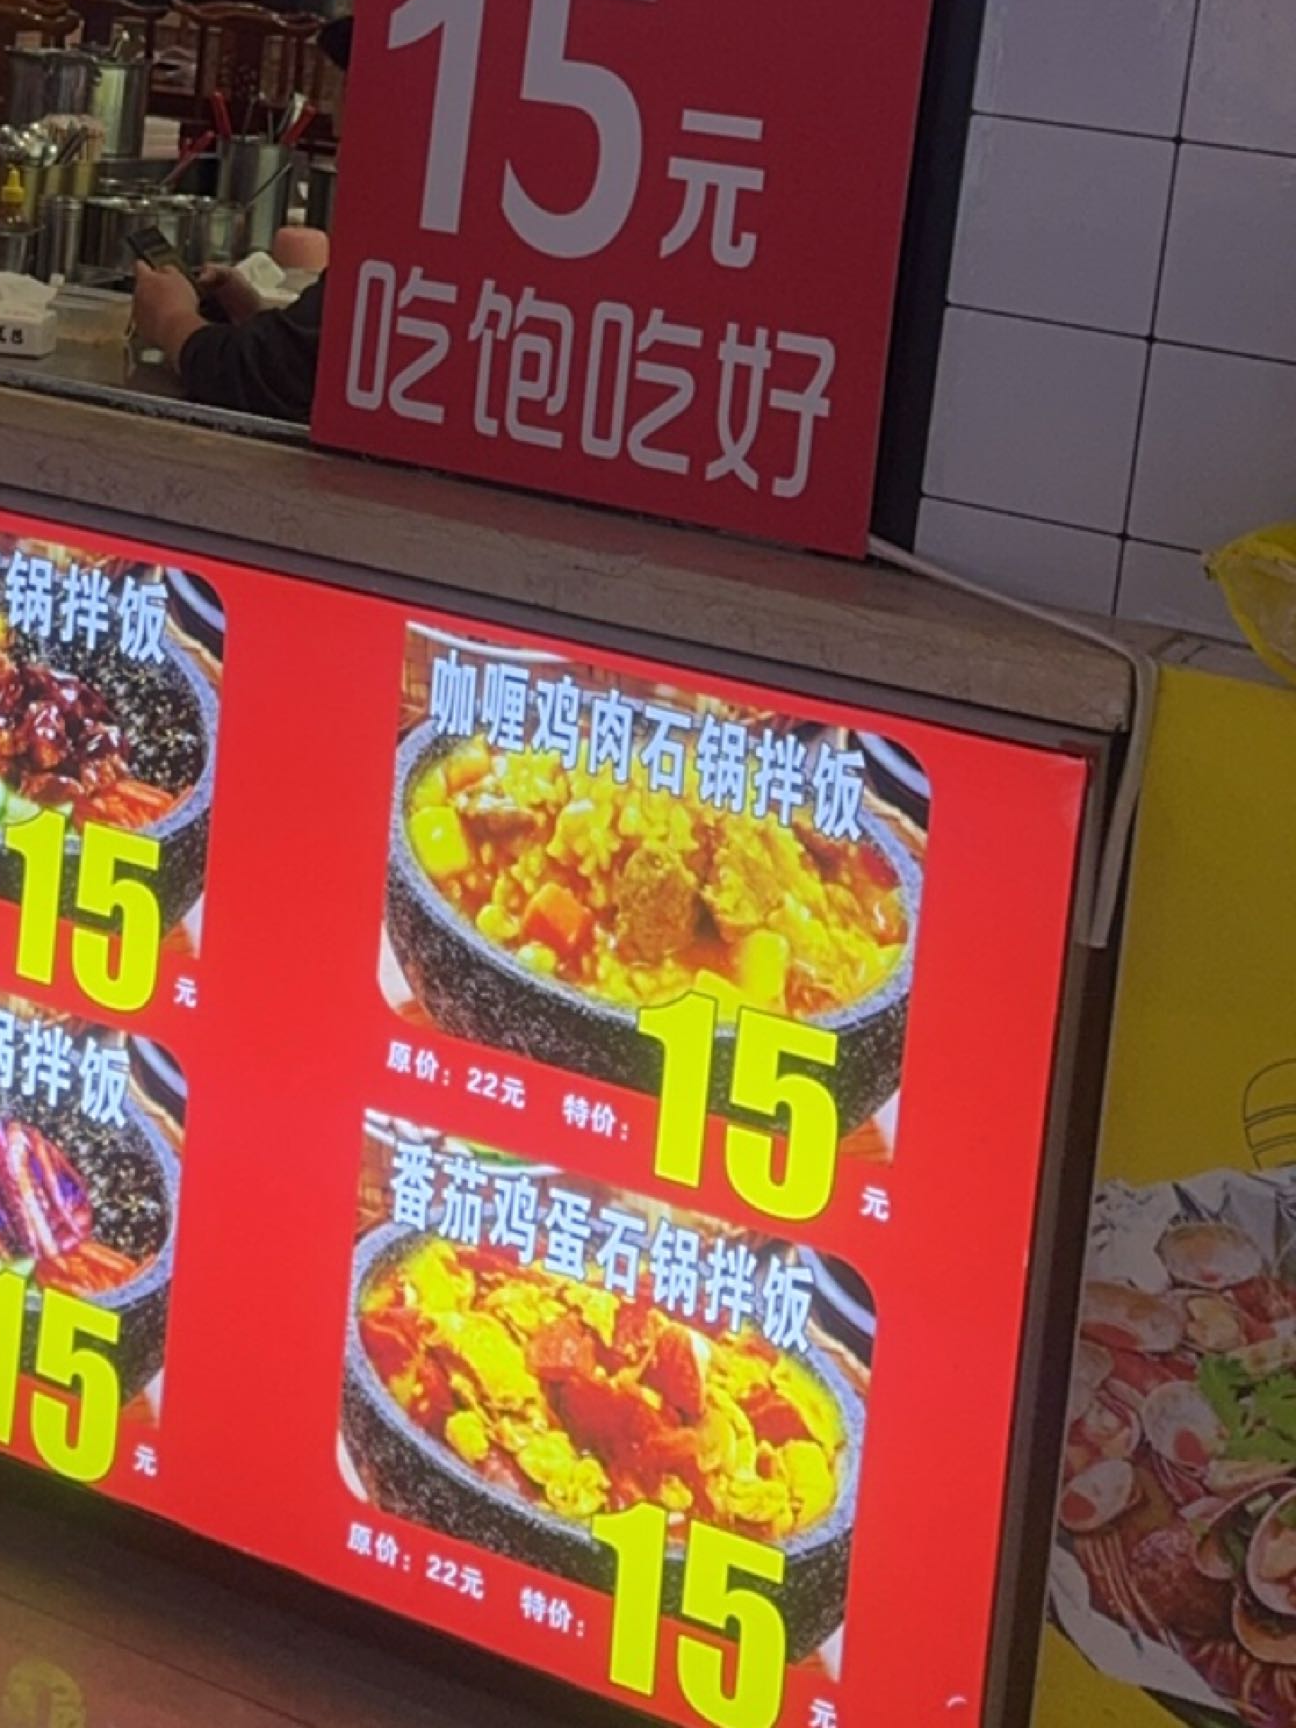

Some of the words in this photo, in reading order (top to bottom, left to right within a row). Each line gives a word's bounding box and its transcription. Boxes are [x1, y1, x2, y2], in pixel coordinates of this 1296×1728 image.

[345, 259, 836, 499] 吃饱吃好
[429, 647, 868, 842] 咖喱鸡肉石锅拌饭
[390, 1138, 814, 1355] 番茄鸡蛋石锅拌饭
